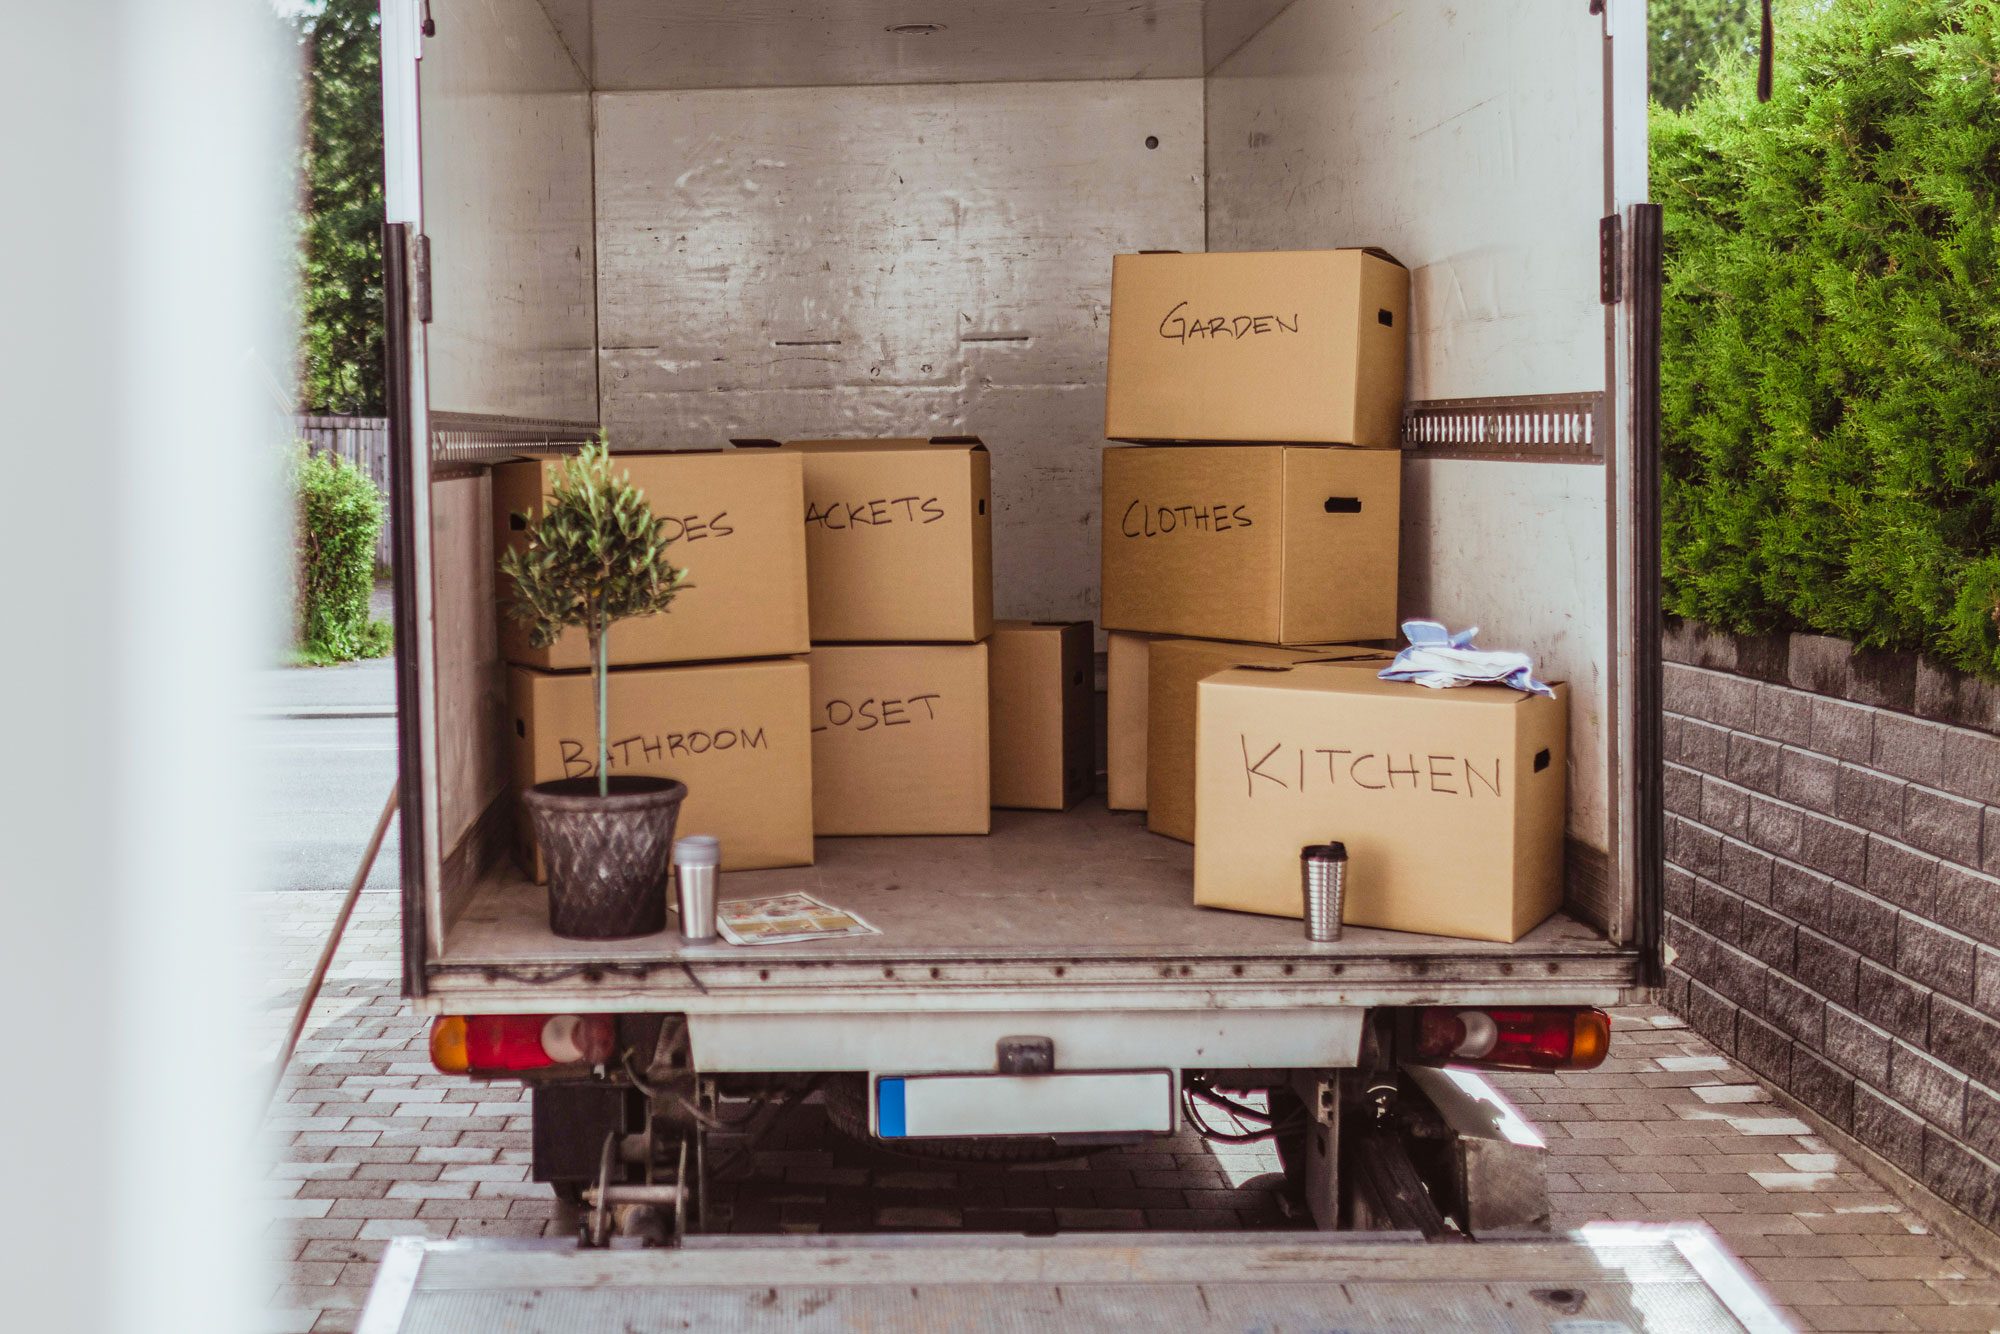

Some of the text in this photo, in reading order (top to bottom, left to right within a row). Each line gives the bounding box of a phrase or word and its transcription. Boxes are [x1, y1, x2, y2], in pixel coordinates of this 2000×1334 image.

[1160, 301, 1299, 345] GARDEN
[805, 497, 945, 530] ACKETS
[1122, 500, 1253, 538] CLOTHES
[559, 727, 768, 780] BATHROOM
[1241, 734, 1501, 798] KITCHEN
